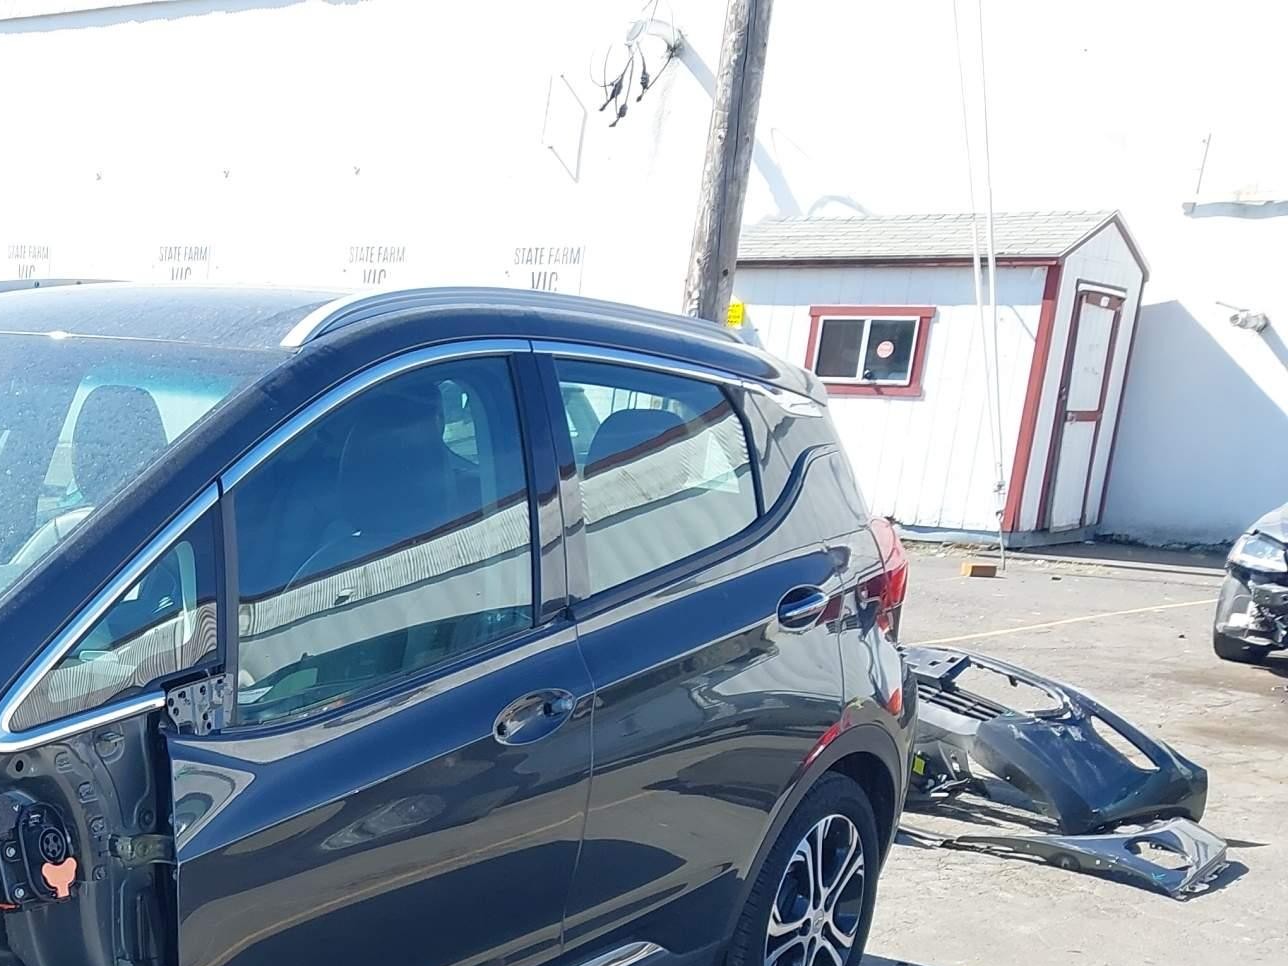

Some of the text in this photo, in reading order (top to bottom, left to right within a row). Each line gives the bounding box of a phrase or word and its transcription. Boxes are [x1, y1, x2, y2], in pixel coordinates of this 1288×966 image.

[159, 245, 208, 262] STATE FARM
[349, 245, 405, 264] STATE FARM
[514, 247, 581, 265] STATE FARM
[531, 271, 558, 291] VIC
